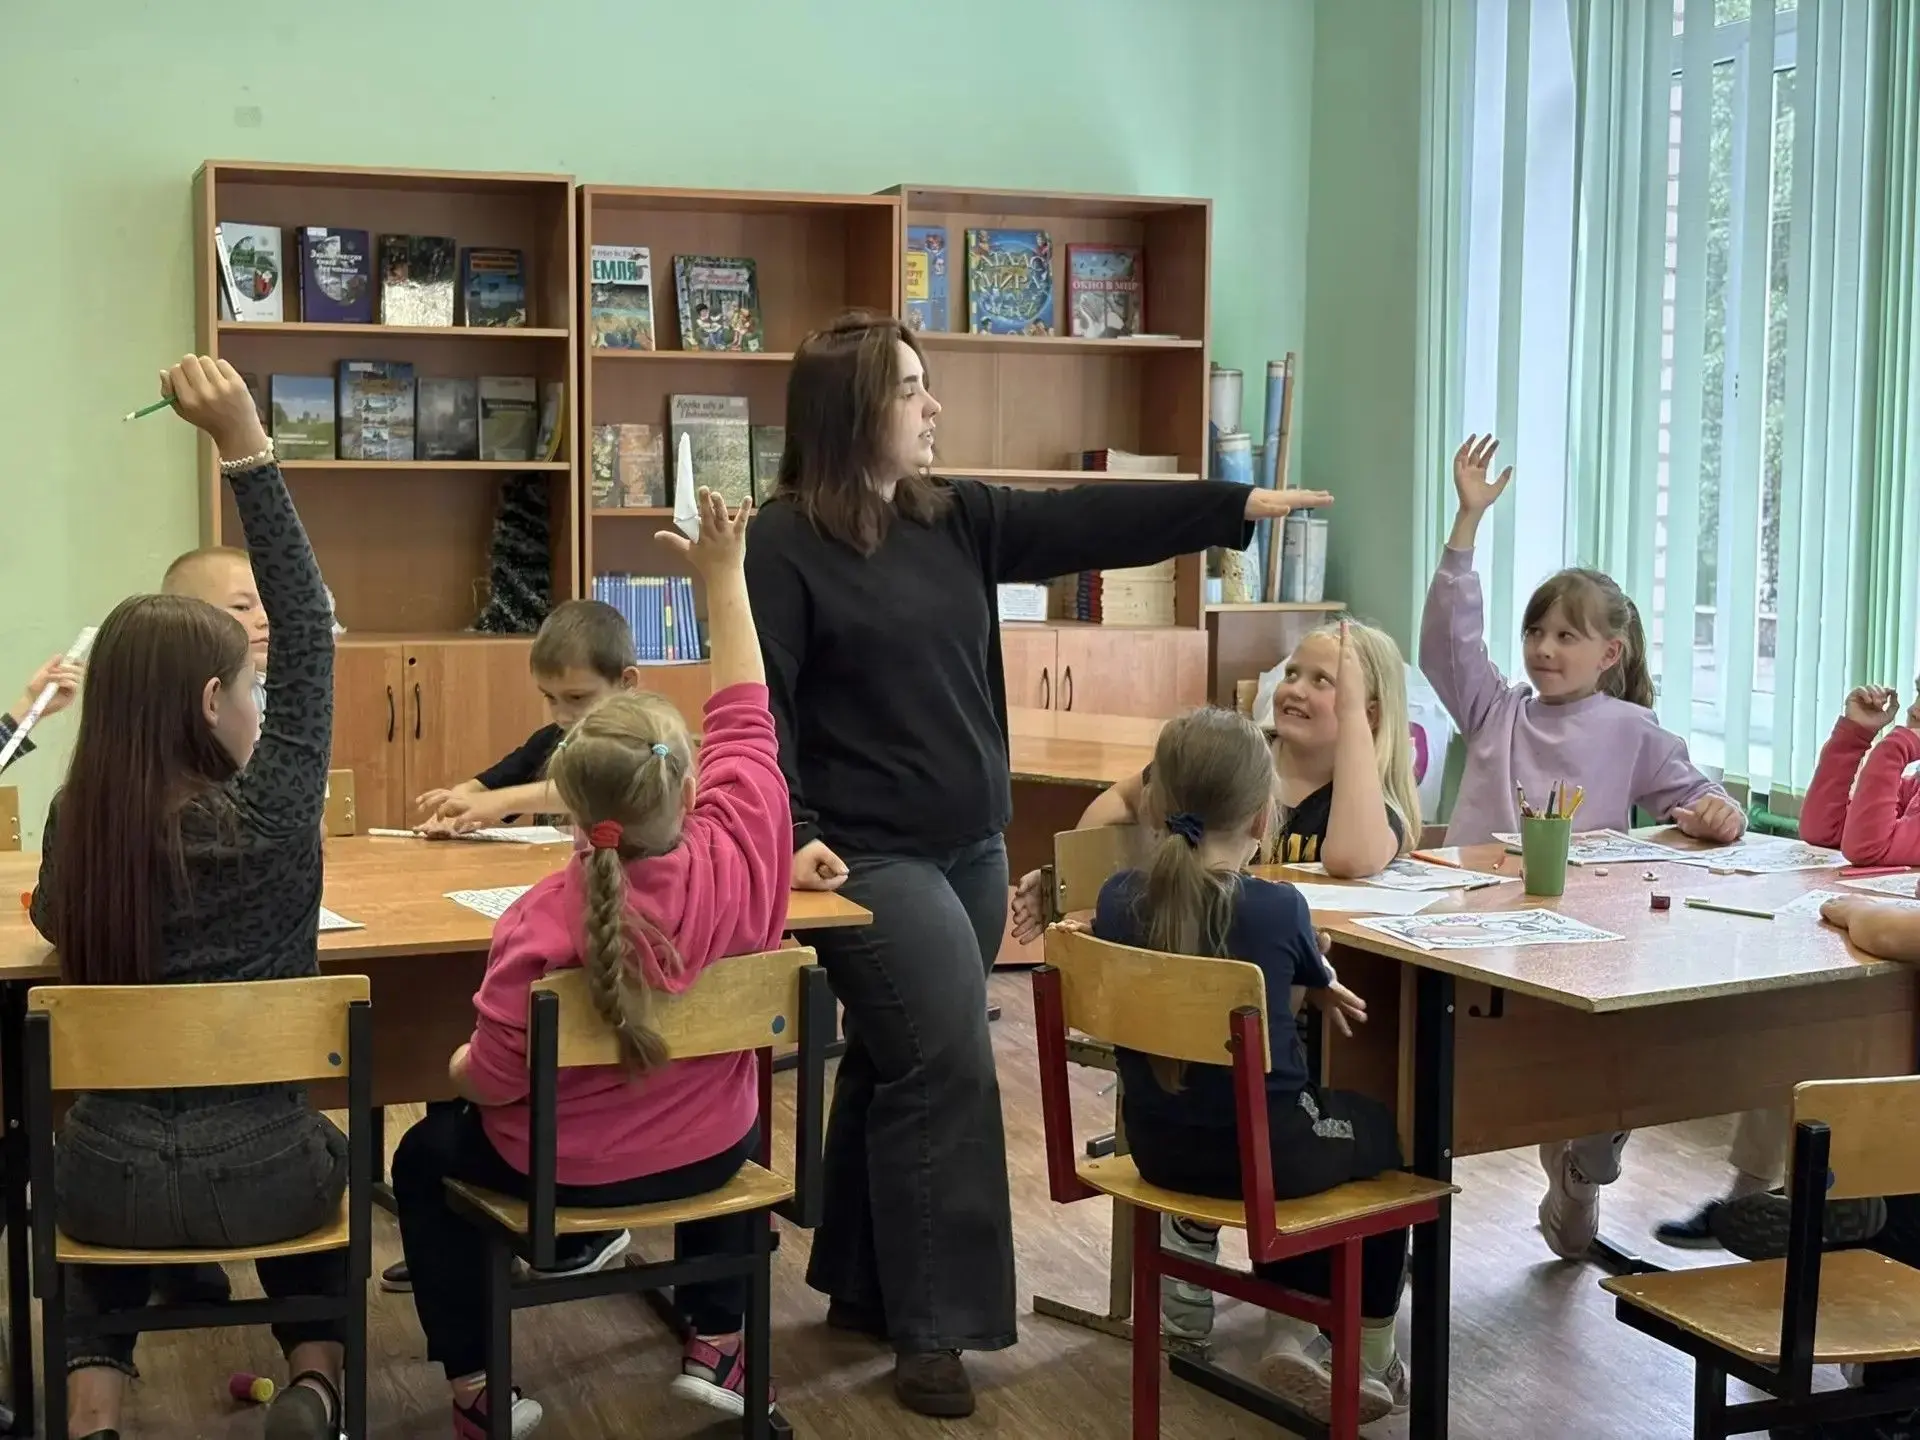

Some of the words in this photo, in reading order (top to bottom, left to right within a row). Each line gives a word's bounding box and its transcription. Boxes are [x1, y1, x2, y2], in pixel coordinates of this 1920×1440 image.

[593, 260, 636, 280] ЕМЛЯ
[975, 270, 1042, 289] МИРА
[1072, 280, 1104, 290] ОКНО
[1106, 280, 1113, 290] В
[1115, 281, 1139, 291] МИР
